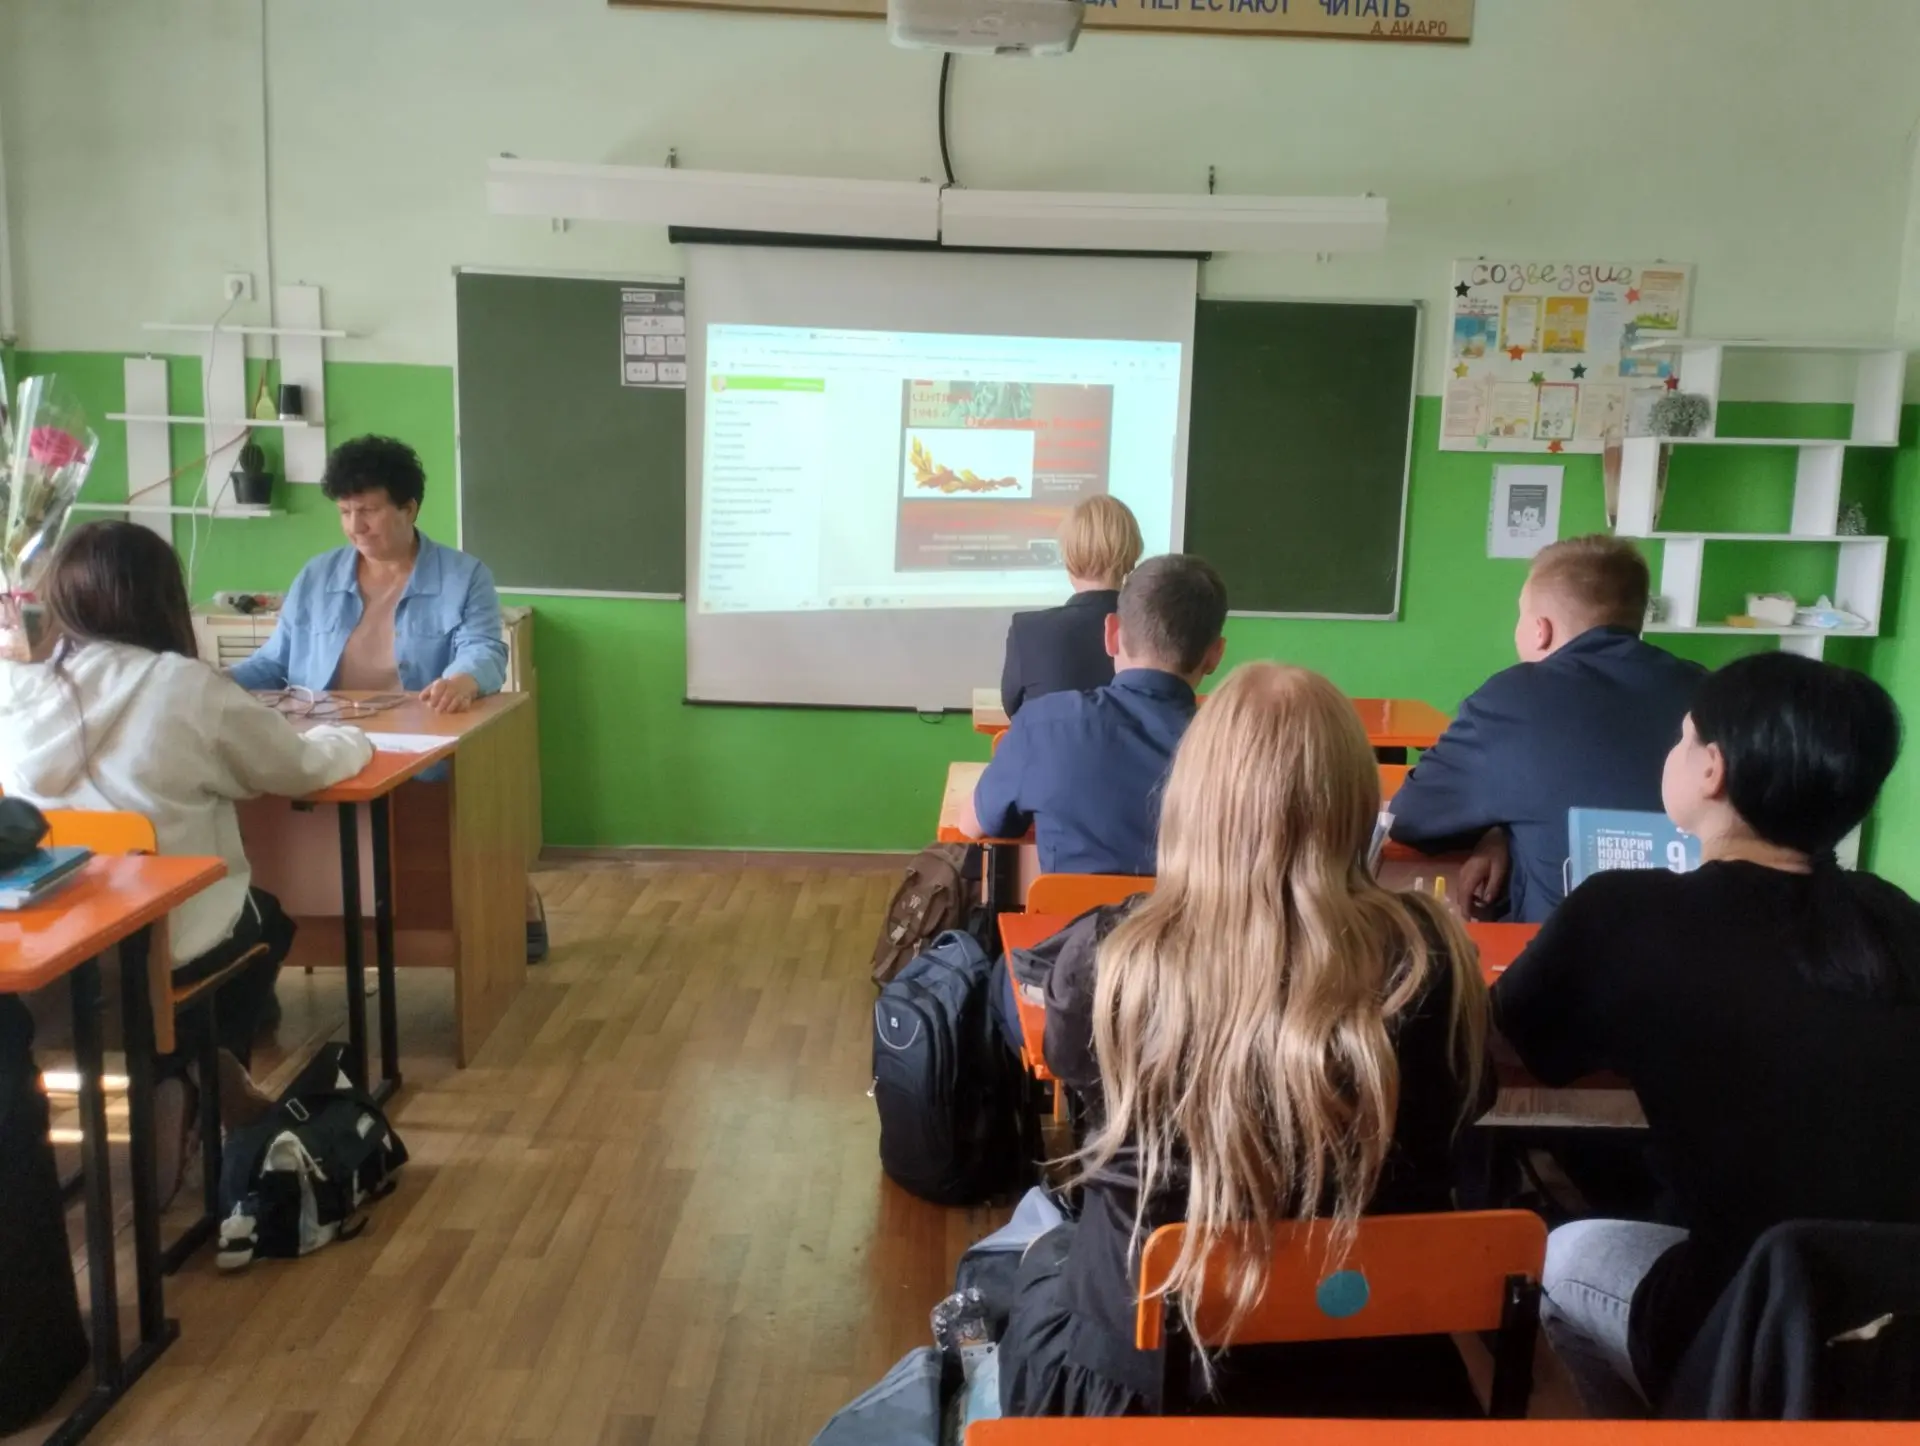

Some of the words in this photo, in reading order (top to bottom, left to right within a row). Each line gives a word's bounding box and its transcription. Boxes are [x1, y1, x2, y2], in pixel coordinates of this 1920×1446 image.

[1319, 0, 1411, 18] ЧИТАТЬ
[1390, 20, 1448, 37] ДИДРО
[1597, 835, 1653, 851] ИСТОРИЯ
[1598, 847, 1645, 862] НОВОГО
[1666, 841, 1687, 874] 9
